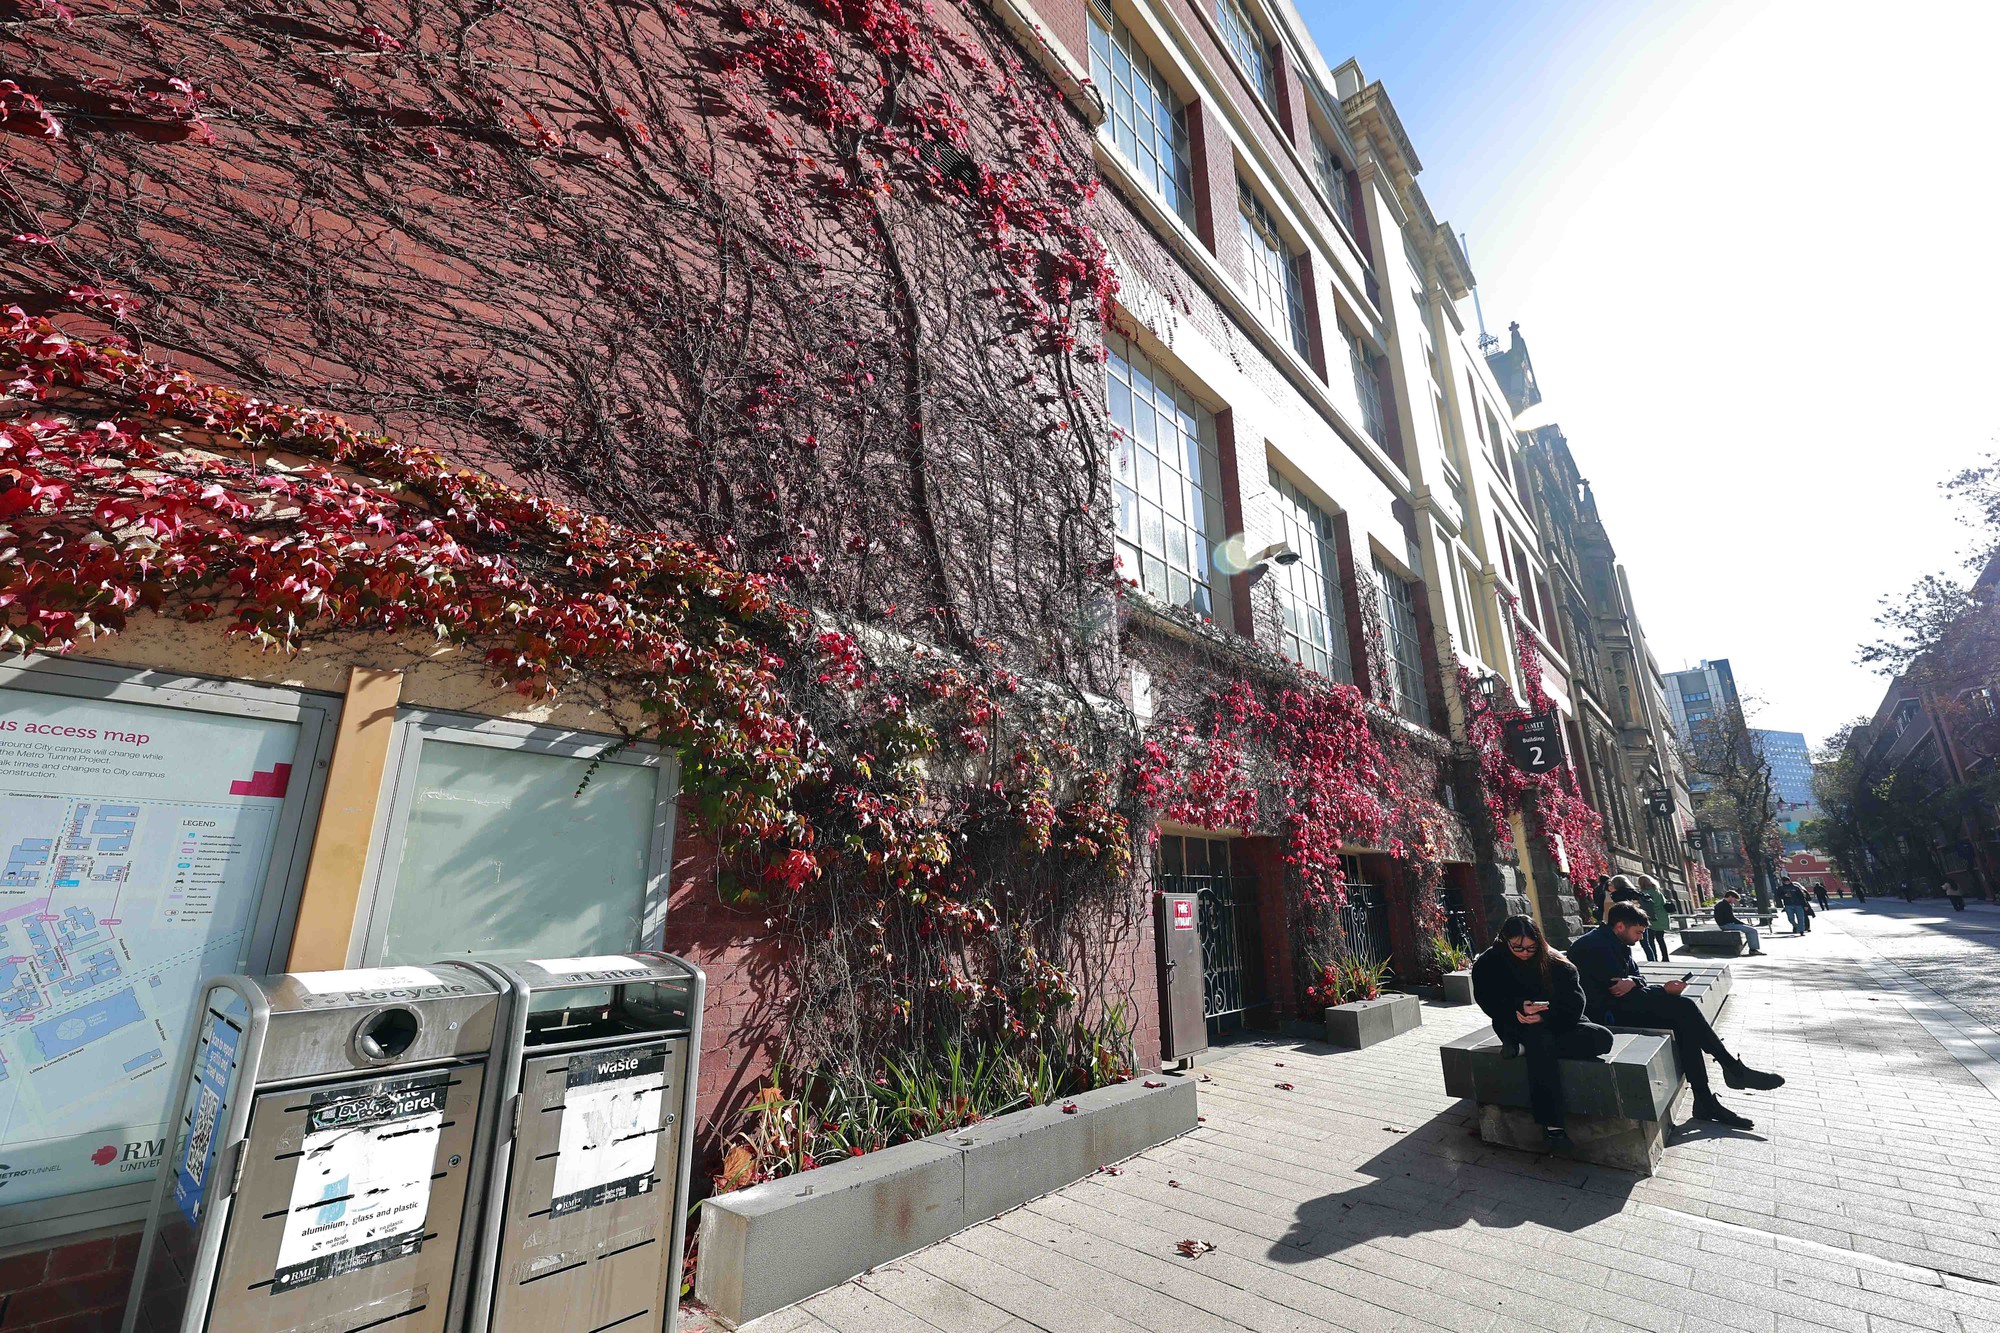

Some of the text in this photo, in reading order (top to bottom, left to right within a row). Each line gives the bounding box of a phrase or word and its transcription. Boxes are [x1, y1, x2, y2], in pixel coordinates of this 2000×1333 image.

[1524, 722, 1544, 730] RMIT
[24, 723, 98, 739] access
[104, 730, 150, 746] map
[16, 750, 44, 758] Metro
[48, 752, 76, 760] Tunnel
[78, 755, 110, 764] Project.
[34, 742, 53, 752] City
[54, 746, 91, 754] campus
[108, 750, 140, 759] change
[1530, 746, 1545, 766] 2
[14, 760, 40, 768] times
[62, 764, 100, 774] changes
[114, 768, 130, 776] City
[132, 770, 166, 778] campus
[1660, 803, 1668, 812] 4
[182, 820, 216, 828] LEGEND
[1694, 840, 1701, 848] 6
[586, 969, 654, 980] Litter
[346, 984, 466, 1002] Recycle
[44, 1054, 68, 1068] Lonsdale
[68, 1048, 84, 1057] Street
[130, 1062, 167, 1081] Lonsdale Street
[340, 1100, 373, 1116] BUSY
[120, 1138, 166, 1162] RM
[120, 1159, 160, 1172] UNIVE
[302, 1220, 348, 1237] aluminium,
[352, 1212, 374, 1226] glass
[376, 1207, 391, 1218] and
[394, 1202, 419, 1215] plastic
[386, 1219, 404, 1230] plastic
[384, 1226, 398, 1234] bags
[331, 1238, 349, 1248] scraps
[334, 1234, 347, 1243] food
[290, 1266, 320, 1280] RMIT
